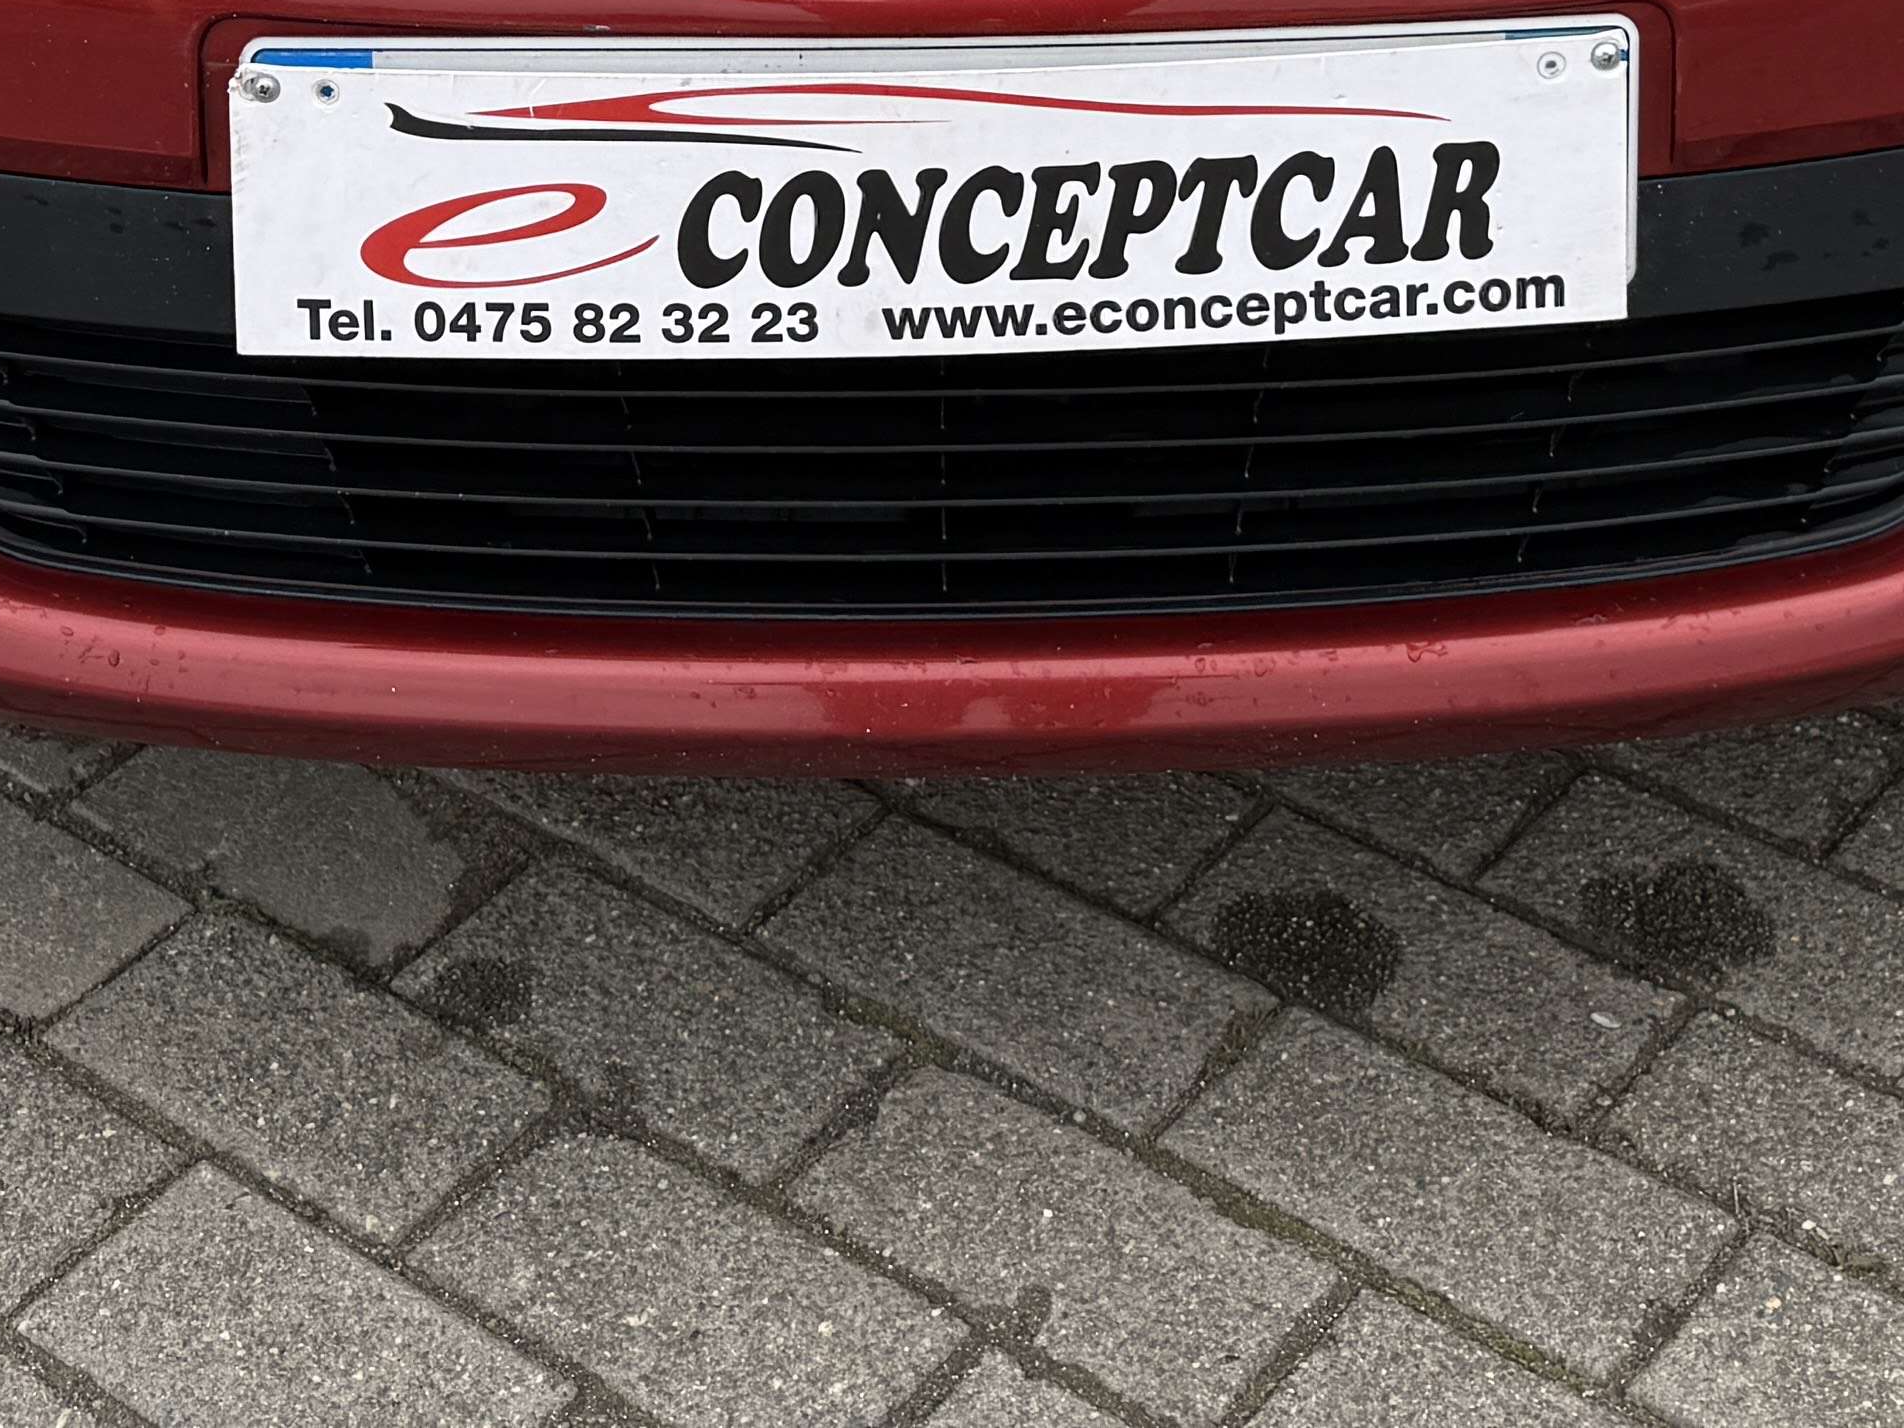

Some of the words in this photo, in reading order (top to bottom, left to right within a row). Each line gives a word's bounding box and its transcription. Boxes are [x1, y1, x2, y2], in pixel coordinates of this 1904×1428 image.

[677, 141, 1500, 289] CONCEPTCAR
[297, 298, 392, 342] Tel.
[414, 301, 552, 343] 0475
[572, 302, 641, 343] 82
[661, 302, 730, 343] 32
[751, 302, 819, 343] 23
[882, 274, 1565, 340] www.econceptcar.com
